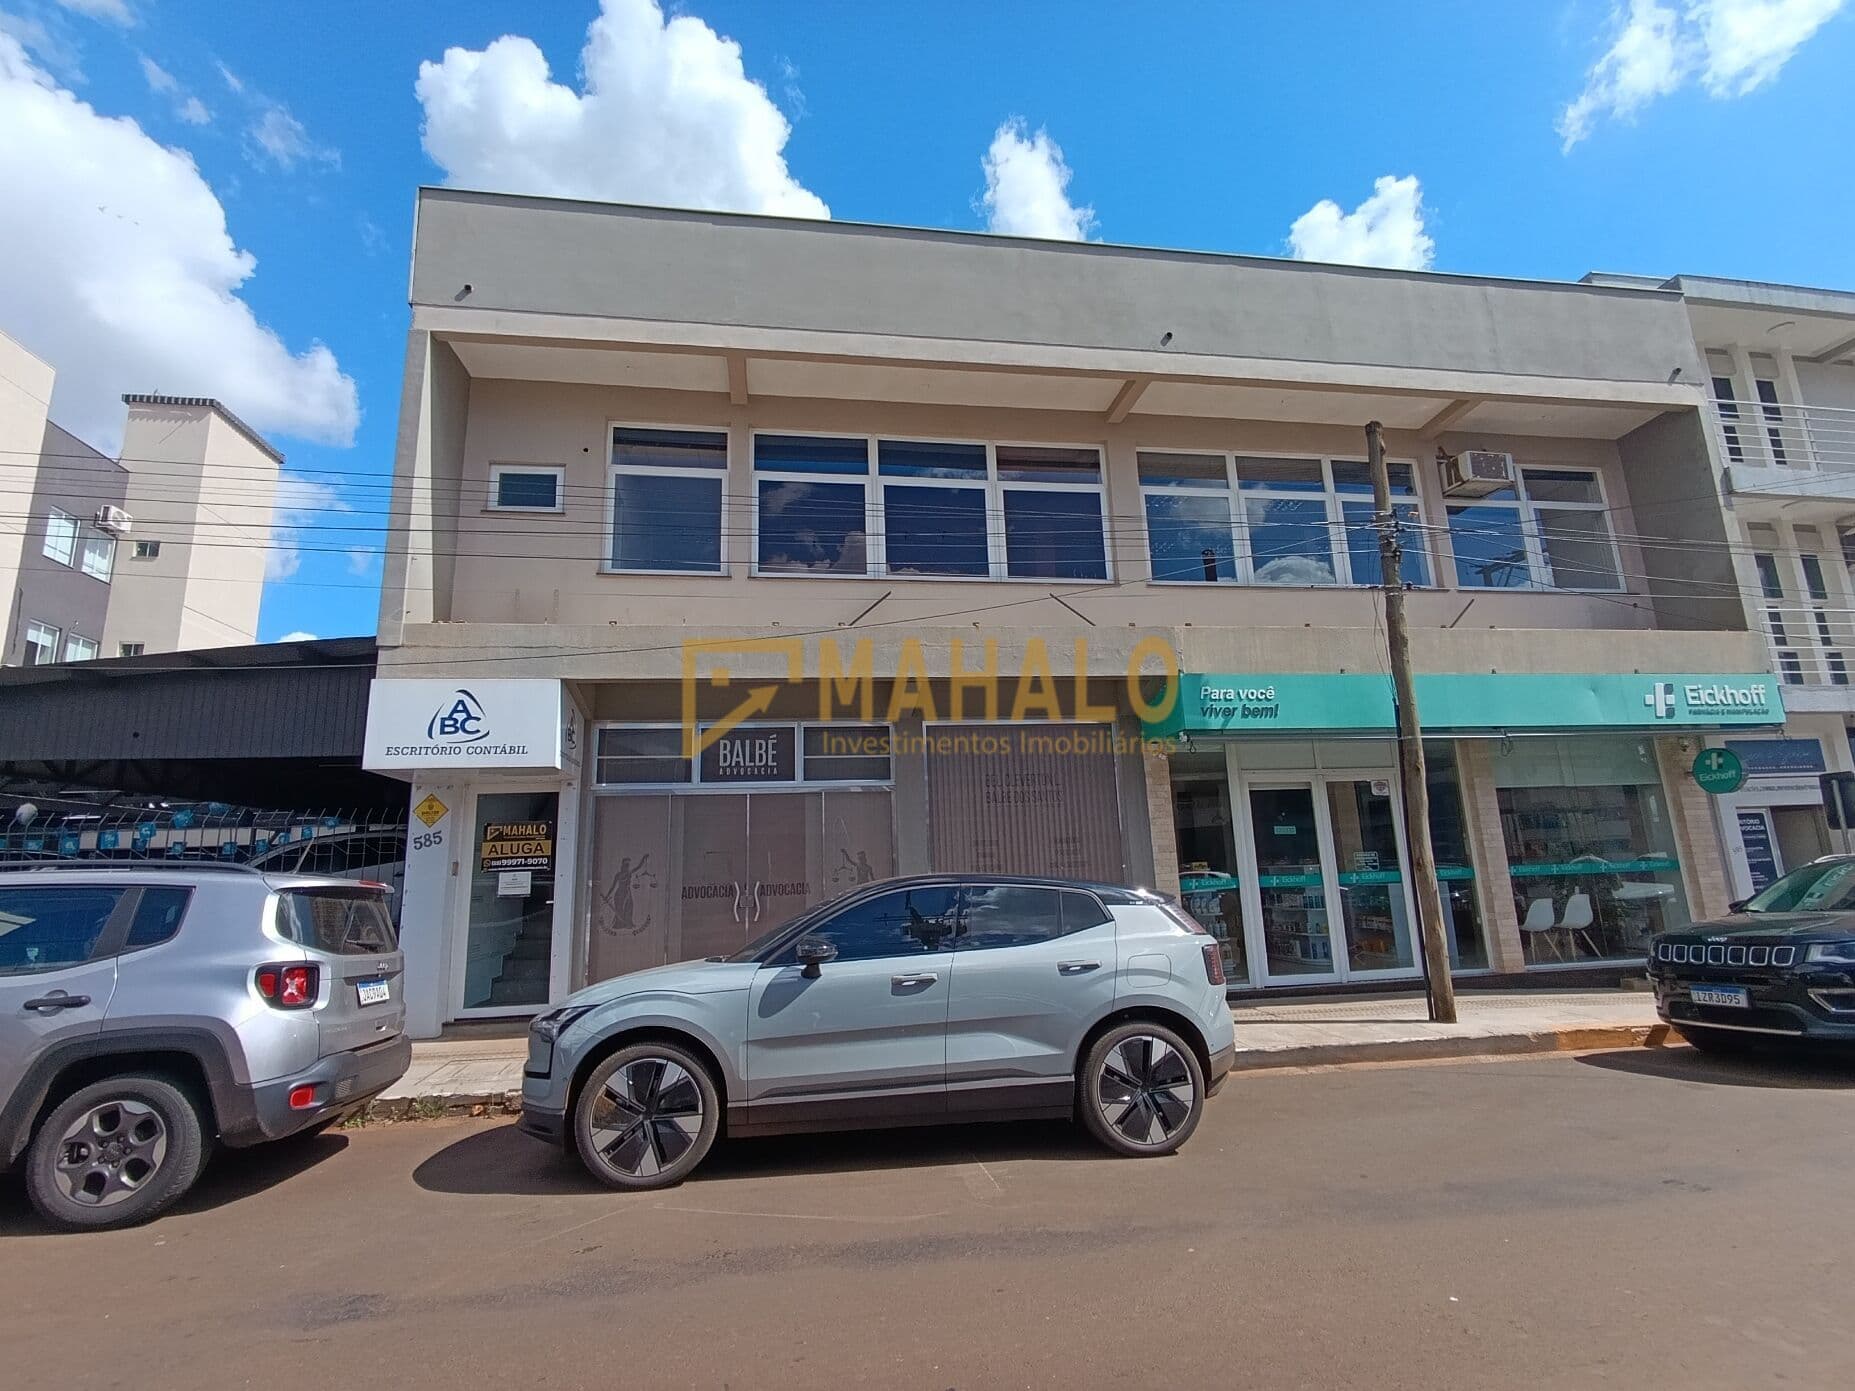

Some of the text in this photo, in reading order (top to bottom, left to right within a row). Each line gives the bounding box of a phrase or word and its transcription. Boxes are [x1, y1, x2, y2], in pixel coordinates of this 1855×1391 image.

[1200, 685, 1275, 700] Para você
[1684, 684, 1766, 706] Eickhoff
[439, 699, 482, 736] ABC
[1200, 703, 1280, 719] viver bem!
[385, 743, 529, 756] ESCRITÓRIO CONTÁBIL
[718, 734, 778, 767] BALBÉ
[719, 767, 778, 776] ADVOCACIA
[1699, 770, 1737, 783] Eickhoff
[503, 824, 547, 836] MAHALO
[413, 830, 443, 851] 585
[488, 842, 545, 856] ALUGA
[681, 884, 734, 900] ADVOCACIA
[759, 882, 811, 897] ADVOCACIA
